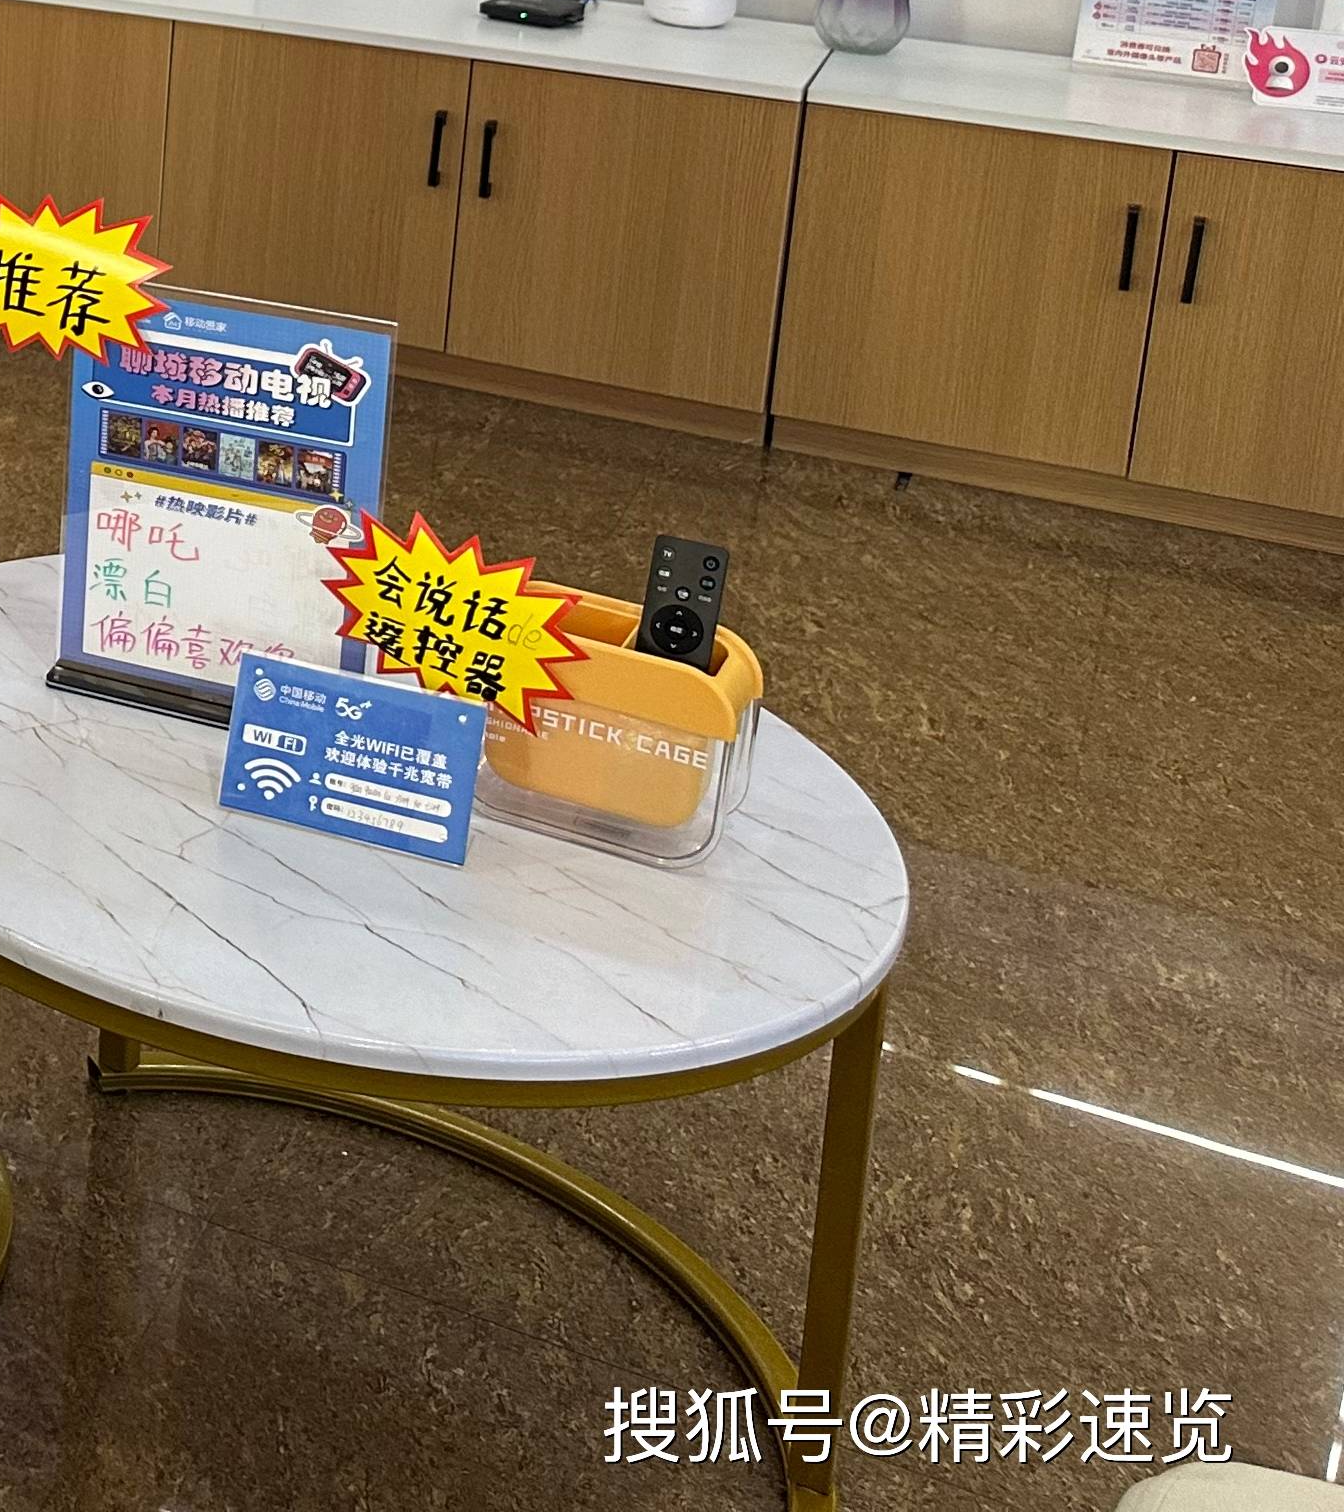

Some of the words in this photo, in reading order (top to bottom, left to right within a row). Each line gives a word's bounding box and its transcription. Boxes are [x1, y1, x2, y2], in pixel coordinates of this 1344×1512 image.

[118, 345, 333, 409] 聊城移动电视
[150, 383, 296, 428] 本月热播推荐
[90, 557, 172, 609] 漂白
[373, 555, 510, 641] 会说话
[363, 610, 507, 703] 遥控器
[279, 683, 327, 705] 中国移动
[279, 695, 299, 708] China
[300, 699, 326, 713] Mobile
[324, 746, 453, 790] 欢迎体验千兆宽带
[334, 729, 448, 771] 全光WIFI已覆盖
[635, 733, 710, 771] CAGE
